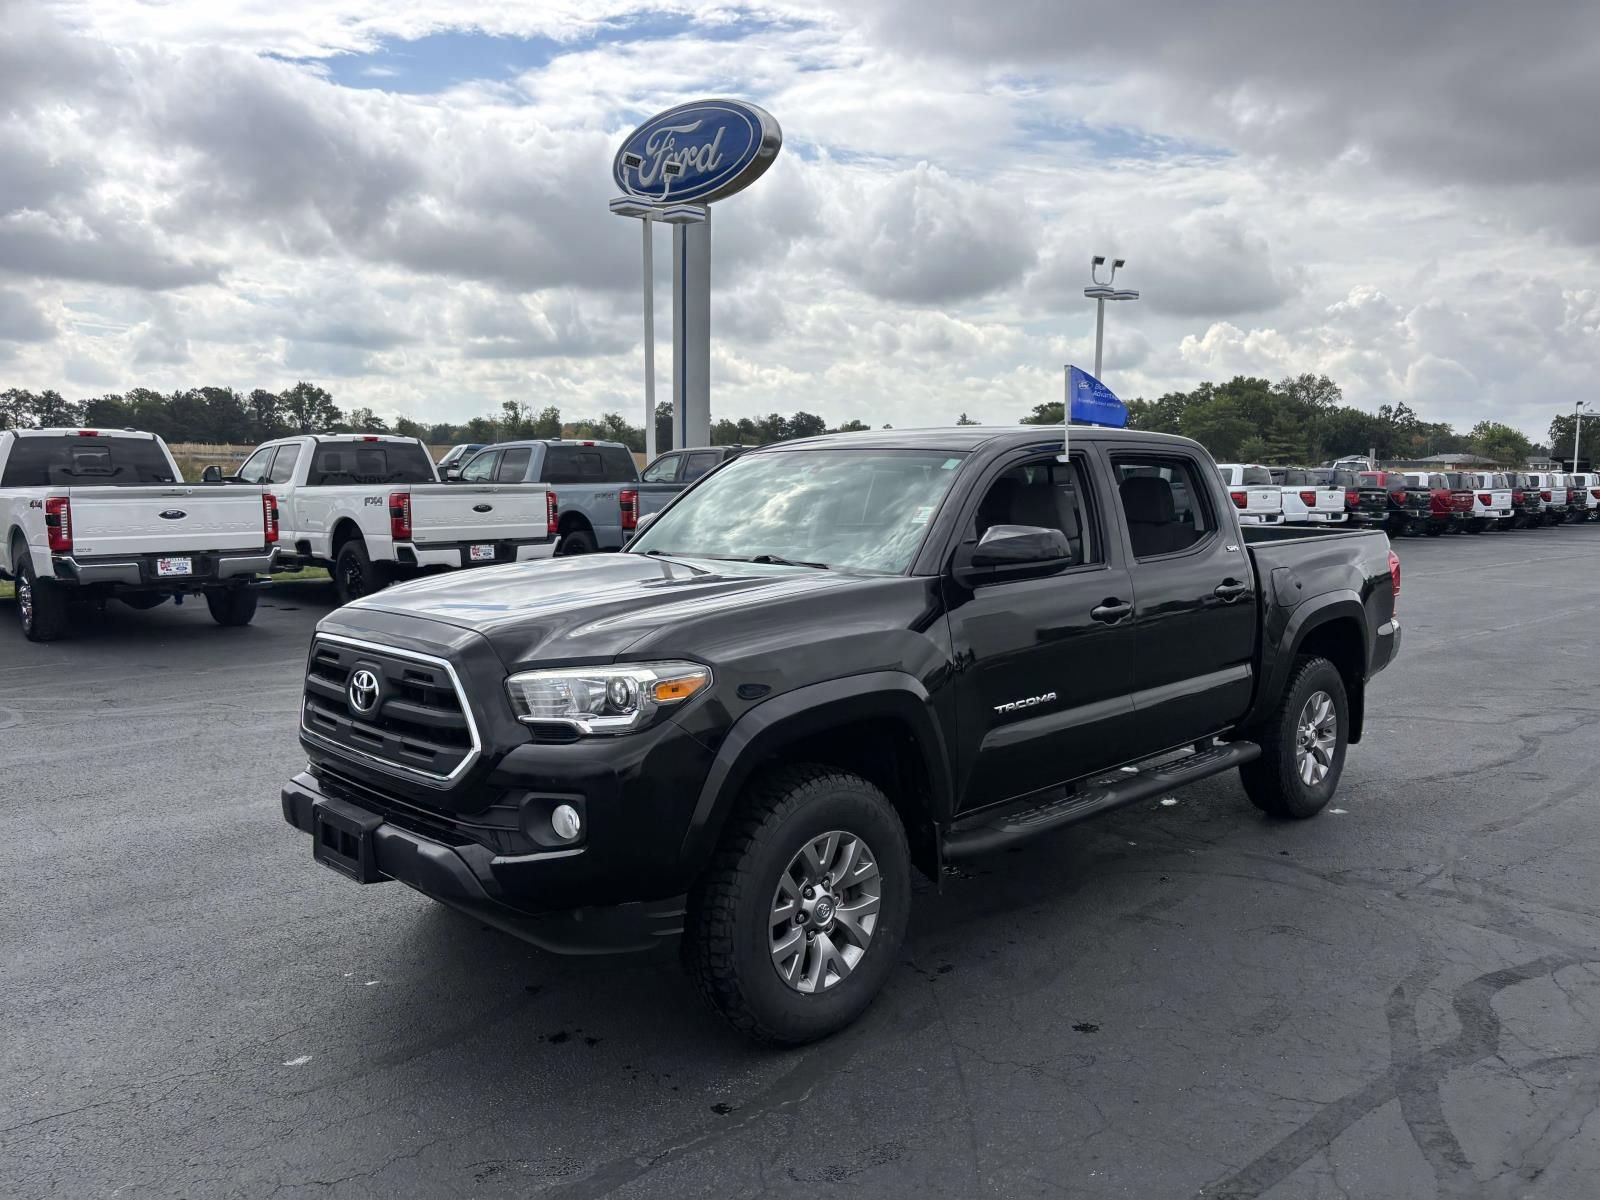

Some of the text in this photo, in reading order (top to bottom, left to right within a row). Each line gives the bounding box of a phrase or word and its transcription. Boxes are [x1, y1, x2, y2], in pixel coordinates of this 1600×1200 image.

[638, 119, 727, 187] Ford
[364, 496, 383, 506] FX4
[993, 691, 1057, 714] TACOMA
